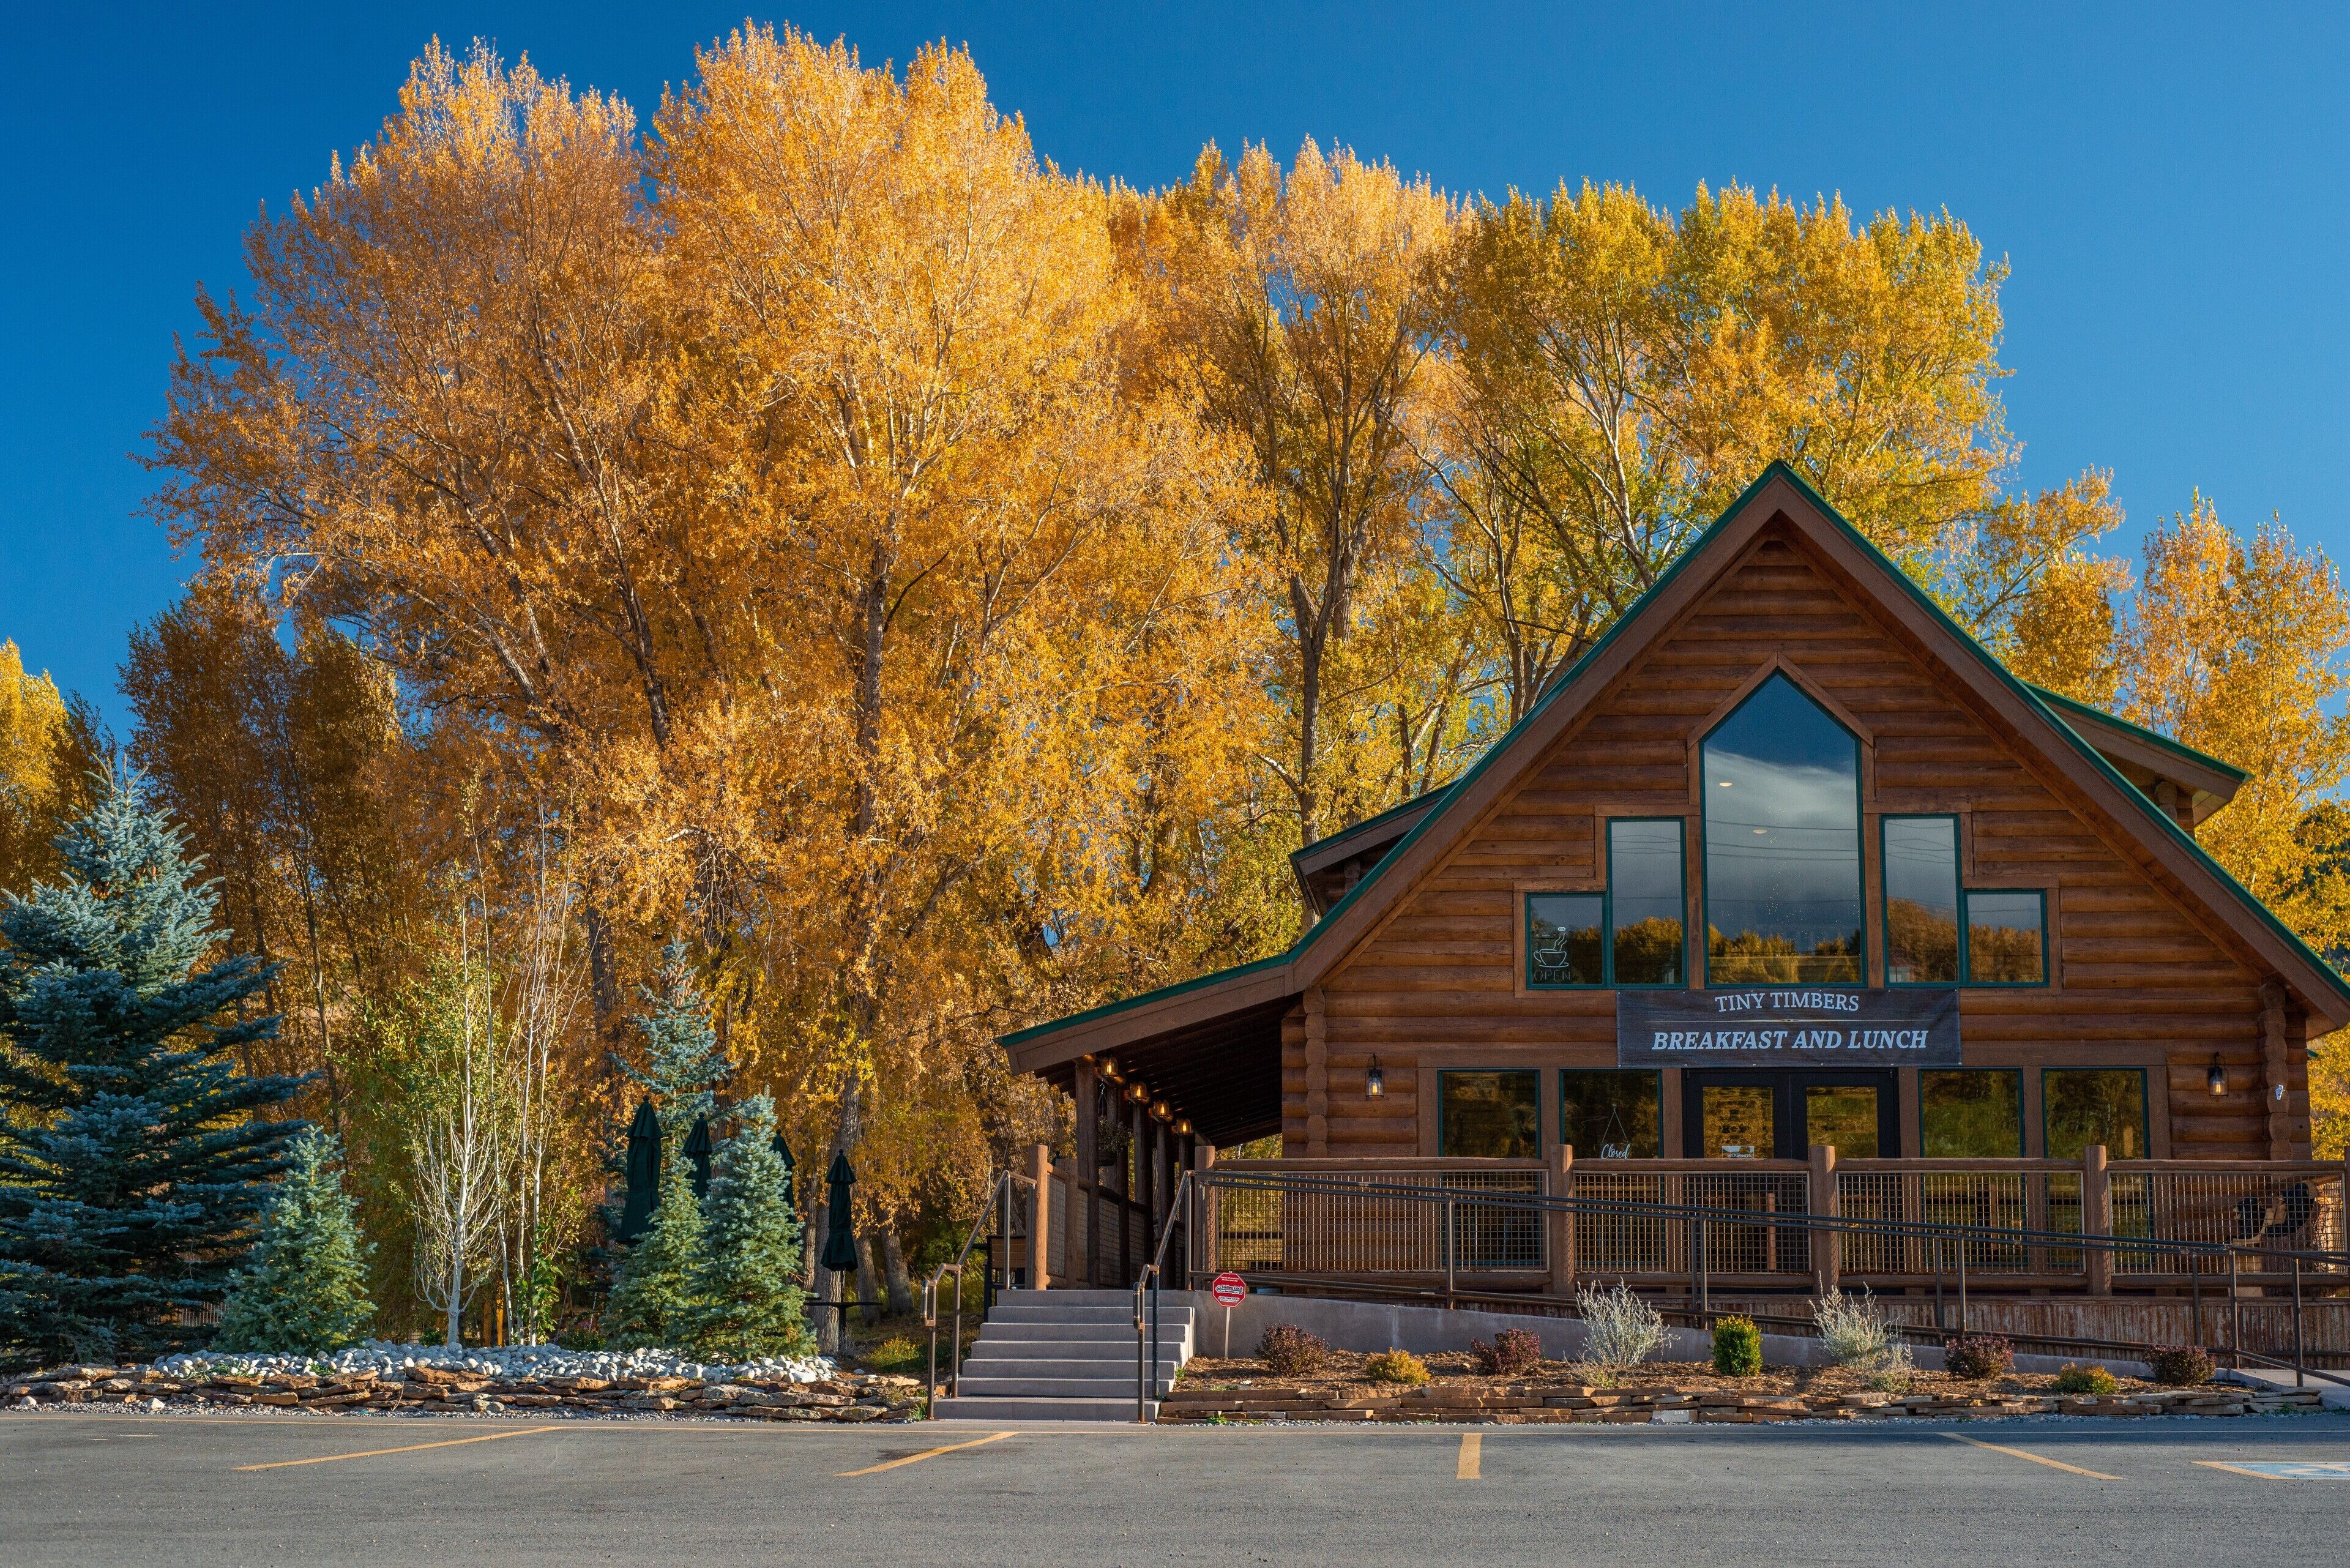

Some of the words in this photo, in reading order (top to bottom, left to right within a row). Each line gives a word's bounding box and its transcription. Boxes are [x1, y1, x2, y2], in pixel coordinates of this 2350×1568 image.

[1534, 969, 1570, 982] OPEN
[1715, 993, 1765, 1012] TINY
[1770, 992, 1859, 1012] TIMBERS
[1652, 1031, 1788, 1050] BREAKFAST
[1791, 1031, 1842, 1049] AND
[1847, 1030, 1929, 1049] LUNCH
[1601, 1143, 1630, 1159] Closed
